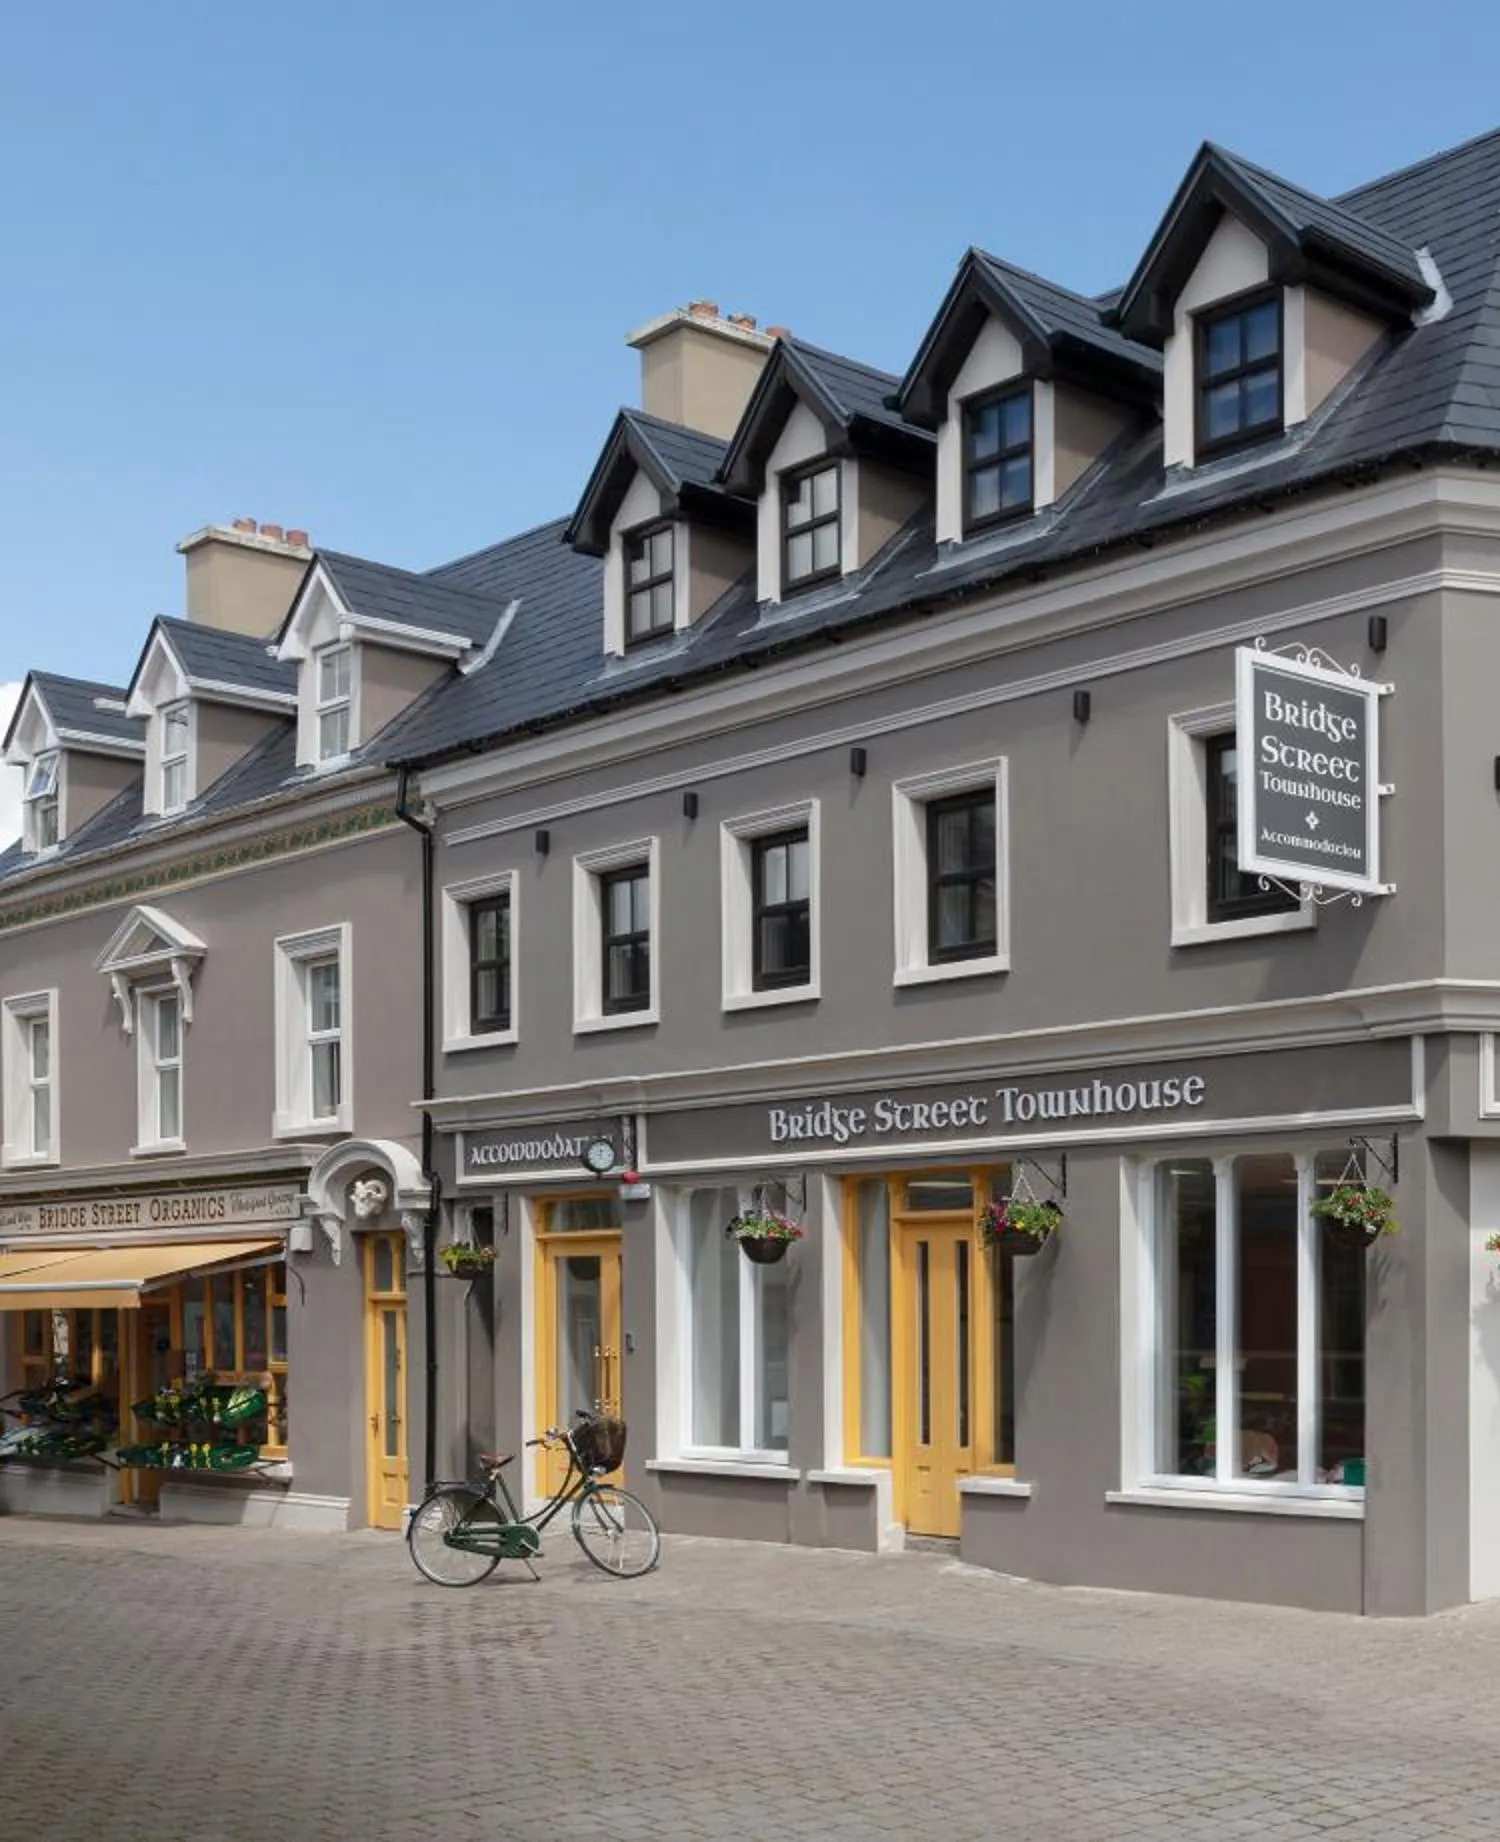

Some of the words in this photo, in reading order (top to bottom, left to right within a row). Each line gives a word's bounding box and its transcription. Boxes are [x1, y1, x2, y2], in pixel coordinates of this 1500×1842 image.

[1264, 690, 1357, 743] Bridge
[1261, 735, 1360, 783] Street
[1260, 769, 1362, 809] Townhouse
[1260, 827, 1361, 859] Accommodation
[768, 1102, 866, 1144] Bridge
[874, 1096, 988, 1134] Street
[996, 1074, 1206, 1123] Townhouse
[471, 1130, 613, 1165] ACCOMMODAT
[38, 1206, 87, 1230] BRIDGE
[91, 1202, 141, 1226] STREET
[149, 1195, 226, 1222] ORGANICS
